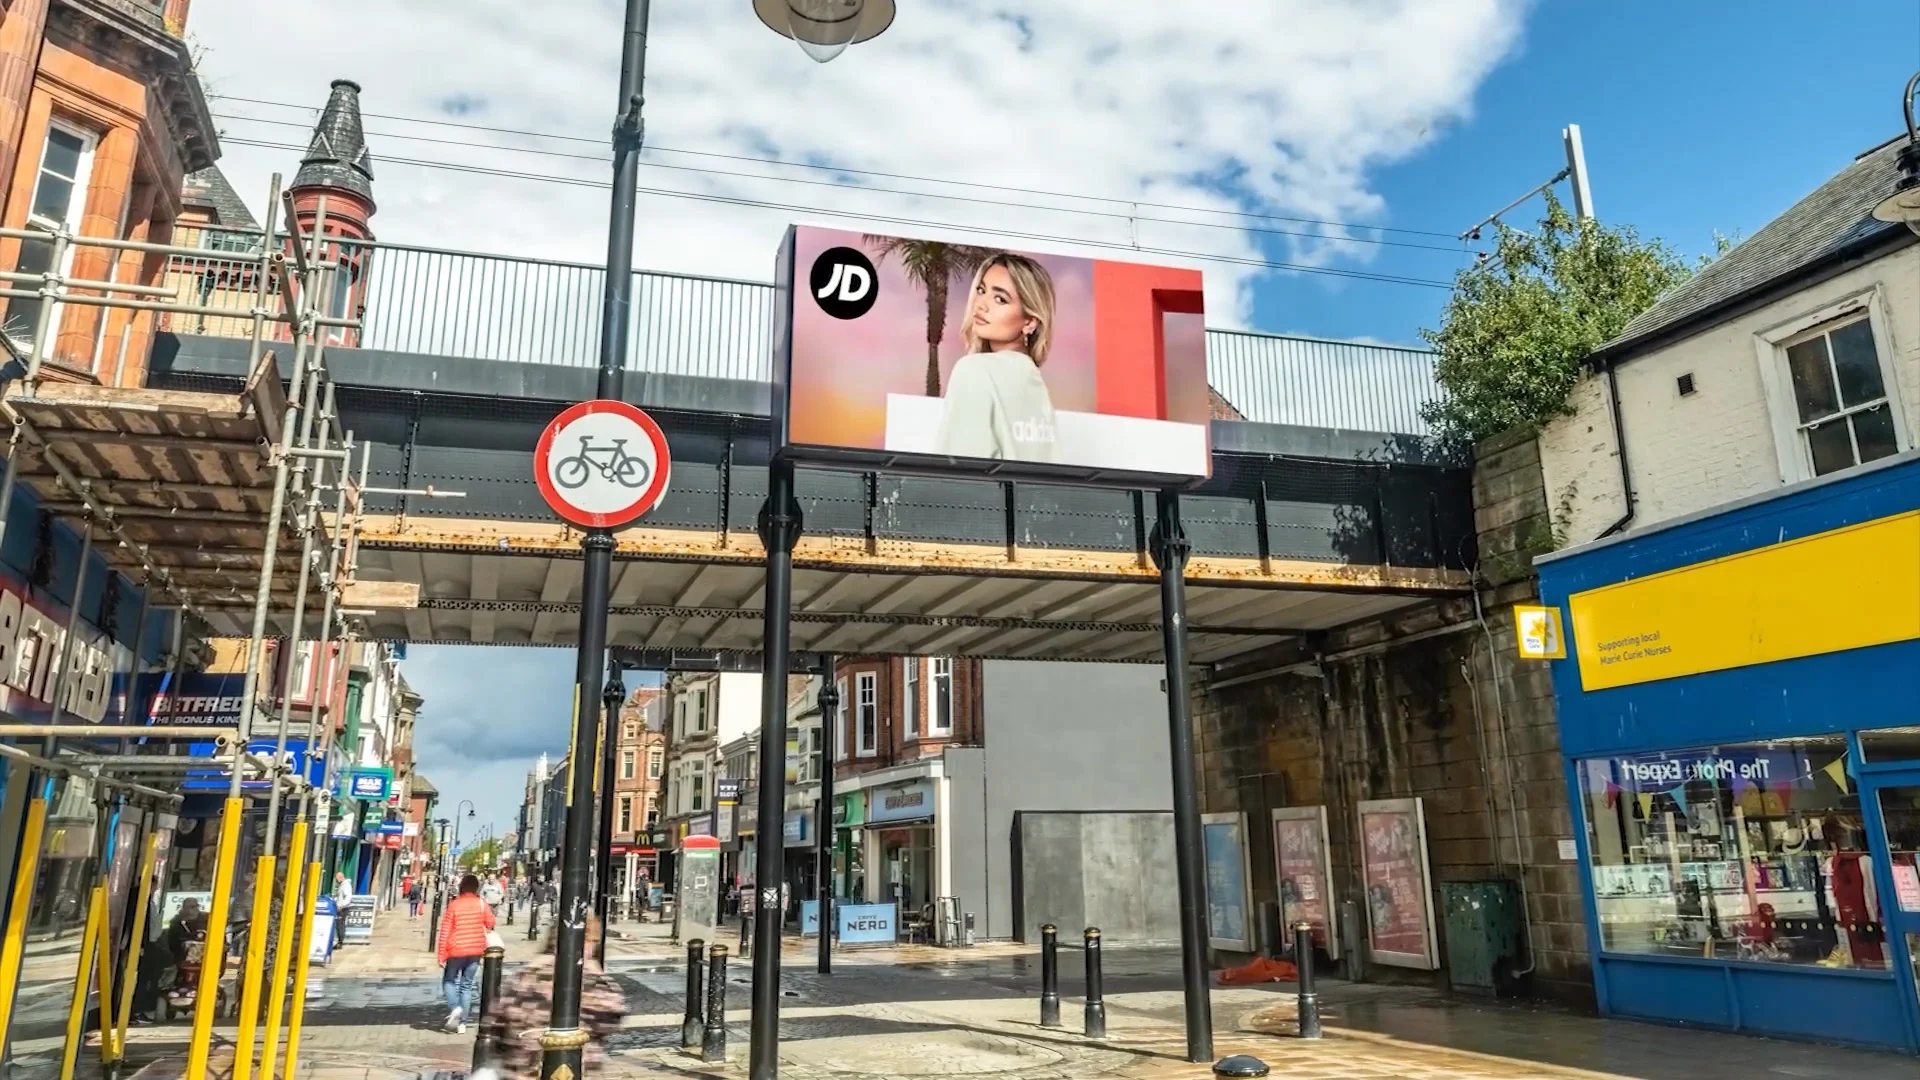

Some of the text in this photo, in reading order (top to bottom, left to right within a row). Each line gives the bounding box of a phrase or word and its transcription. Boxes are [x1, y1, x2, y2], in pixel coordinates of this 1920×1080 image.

[817, 262, 872, 302] JD
[1597, 630, 1660, 651] Supporting local
[1600, 644, 1672, 665] Marie Curie Nurses
[175, 716, 214, 724] BONUS
[847, 920, 888, 932] NERO
